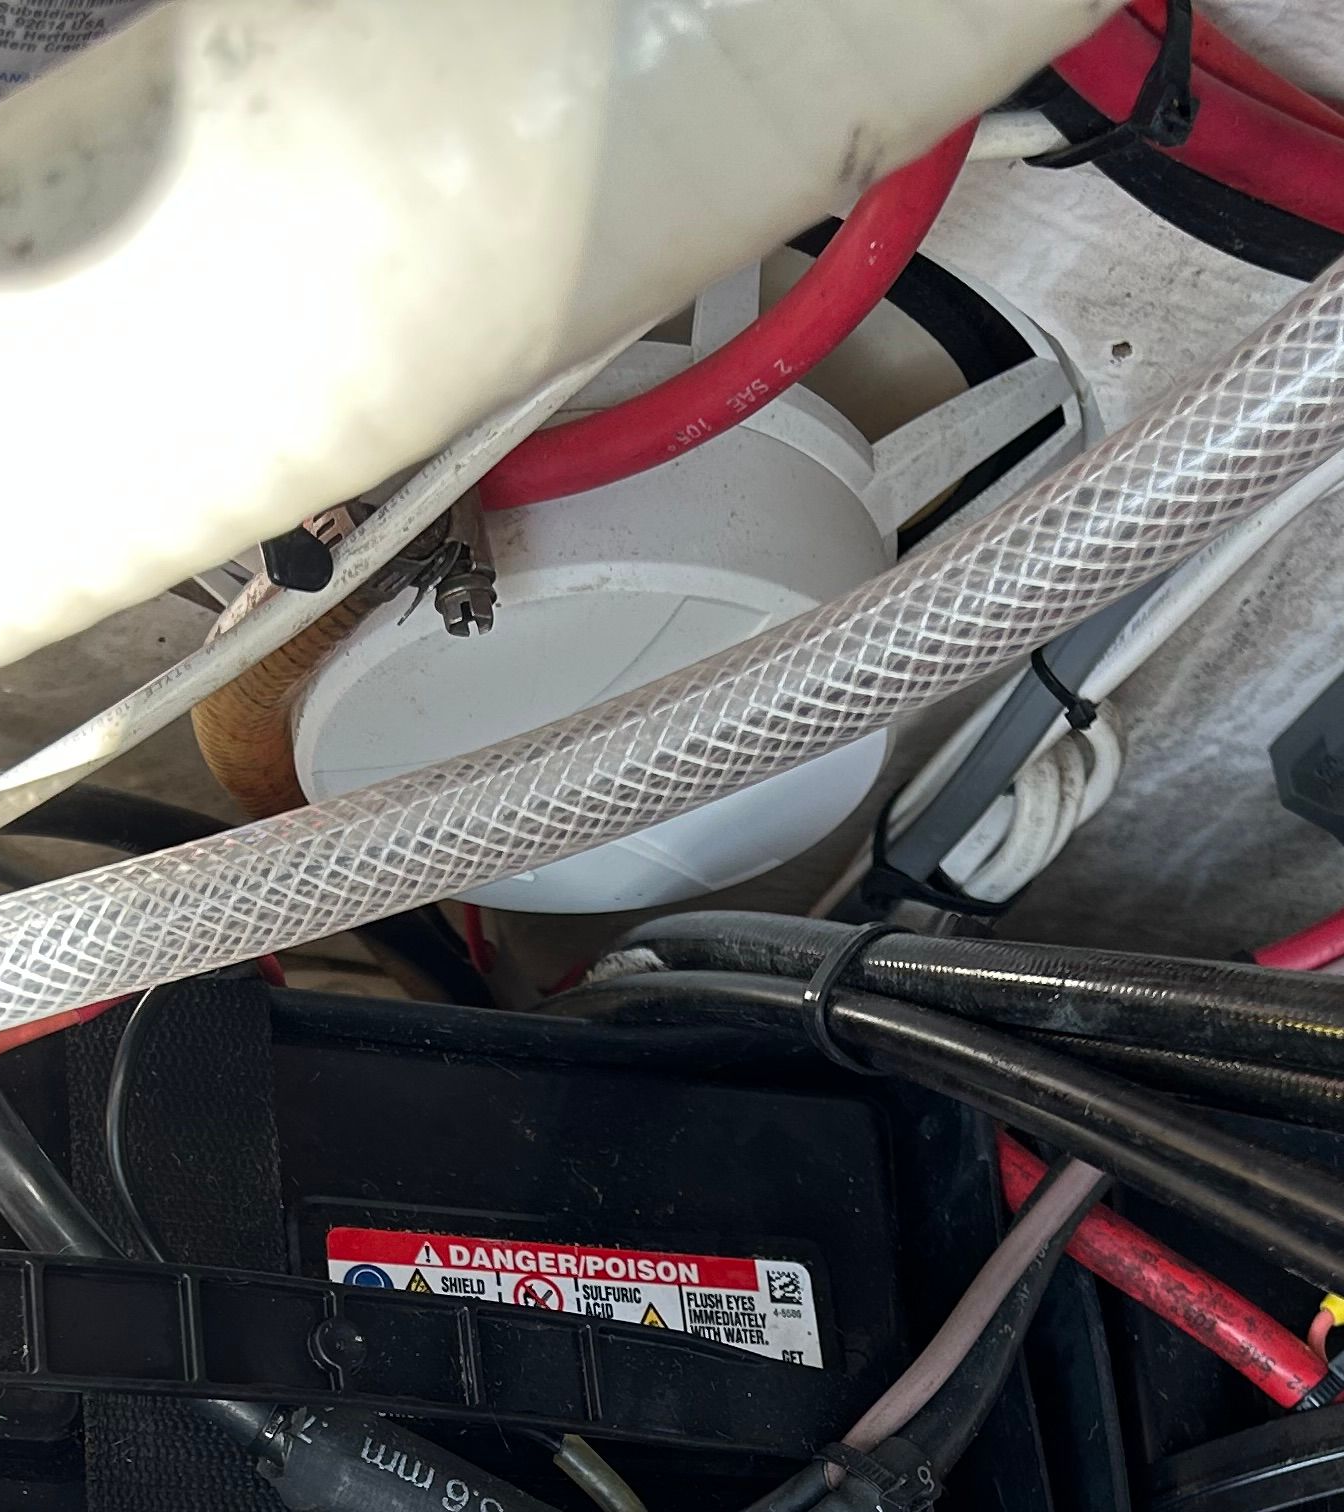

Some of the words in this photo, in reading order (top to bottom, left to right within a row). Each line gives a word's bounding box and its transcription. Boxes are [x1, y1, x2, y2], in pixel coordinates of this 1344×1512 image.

[448, 1244, 700, 1284] DANGER/POISON
[441, 1275, 486, 1296] SHIELD
[582, 1284, 642, 1305] SULFURIC
[584, 1303, 614, 1319] ACID
[686, 1292, 724, 1310] FLUSH
[726, 1295, 755, 1311] EYES
[689, 1309, 767, 1330] IMMEDIATELY
[690, 1325, 721, 1343] WITH
[724, 1327, 769, 1346] WATER.
[360, 1436, 436, 1491] mm
